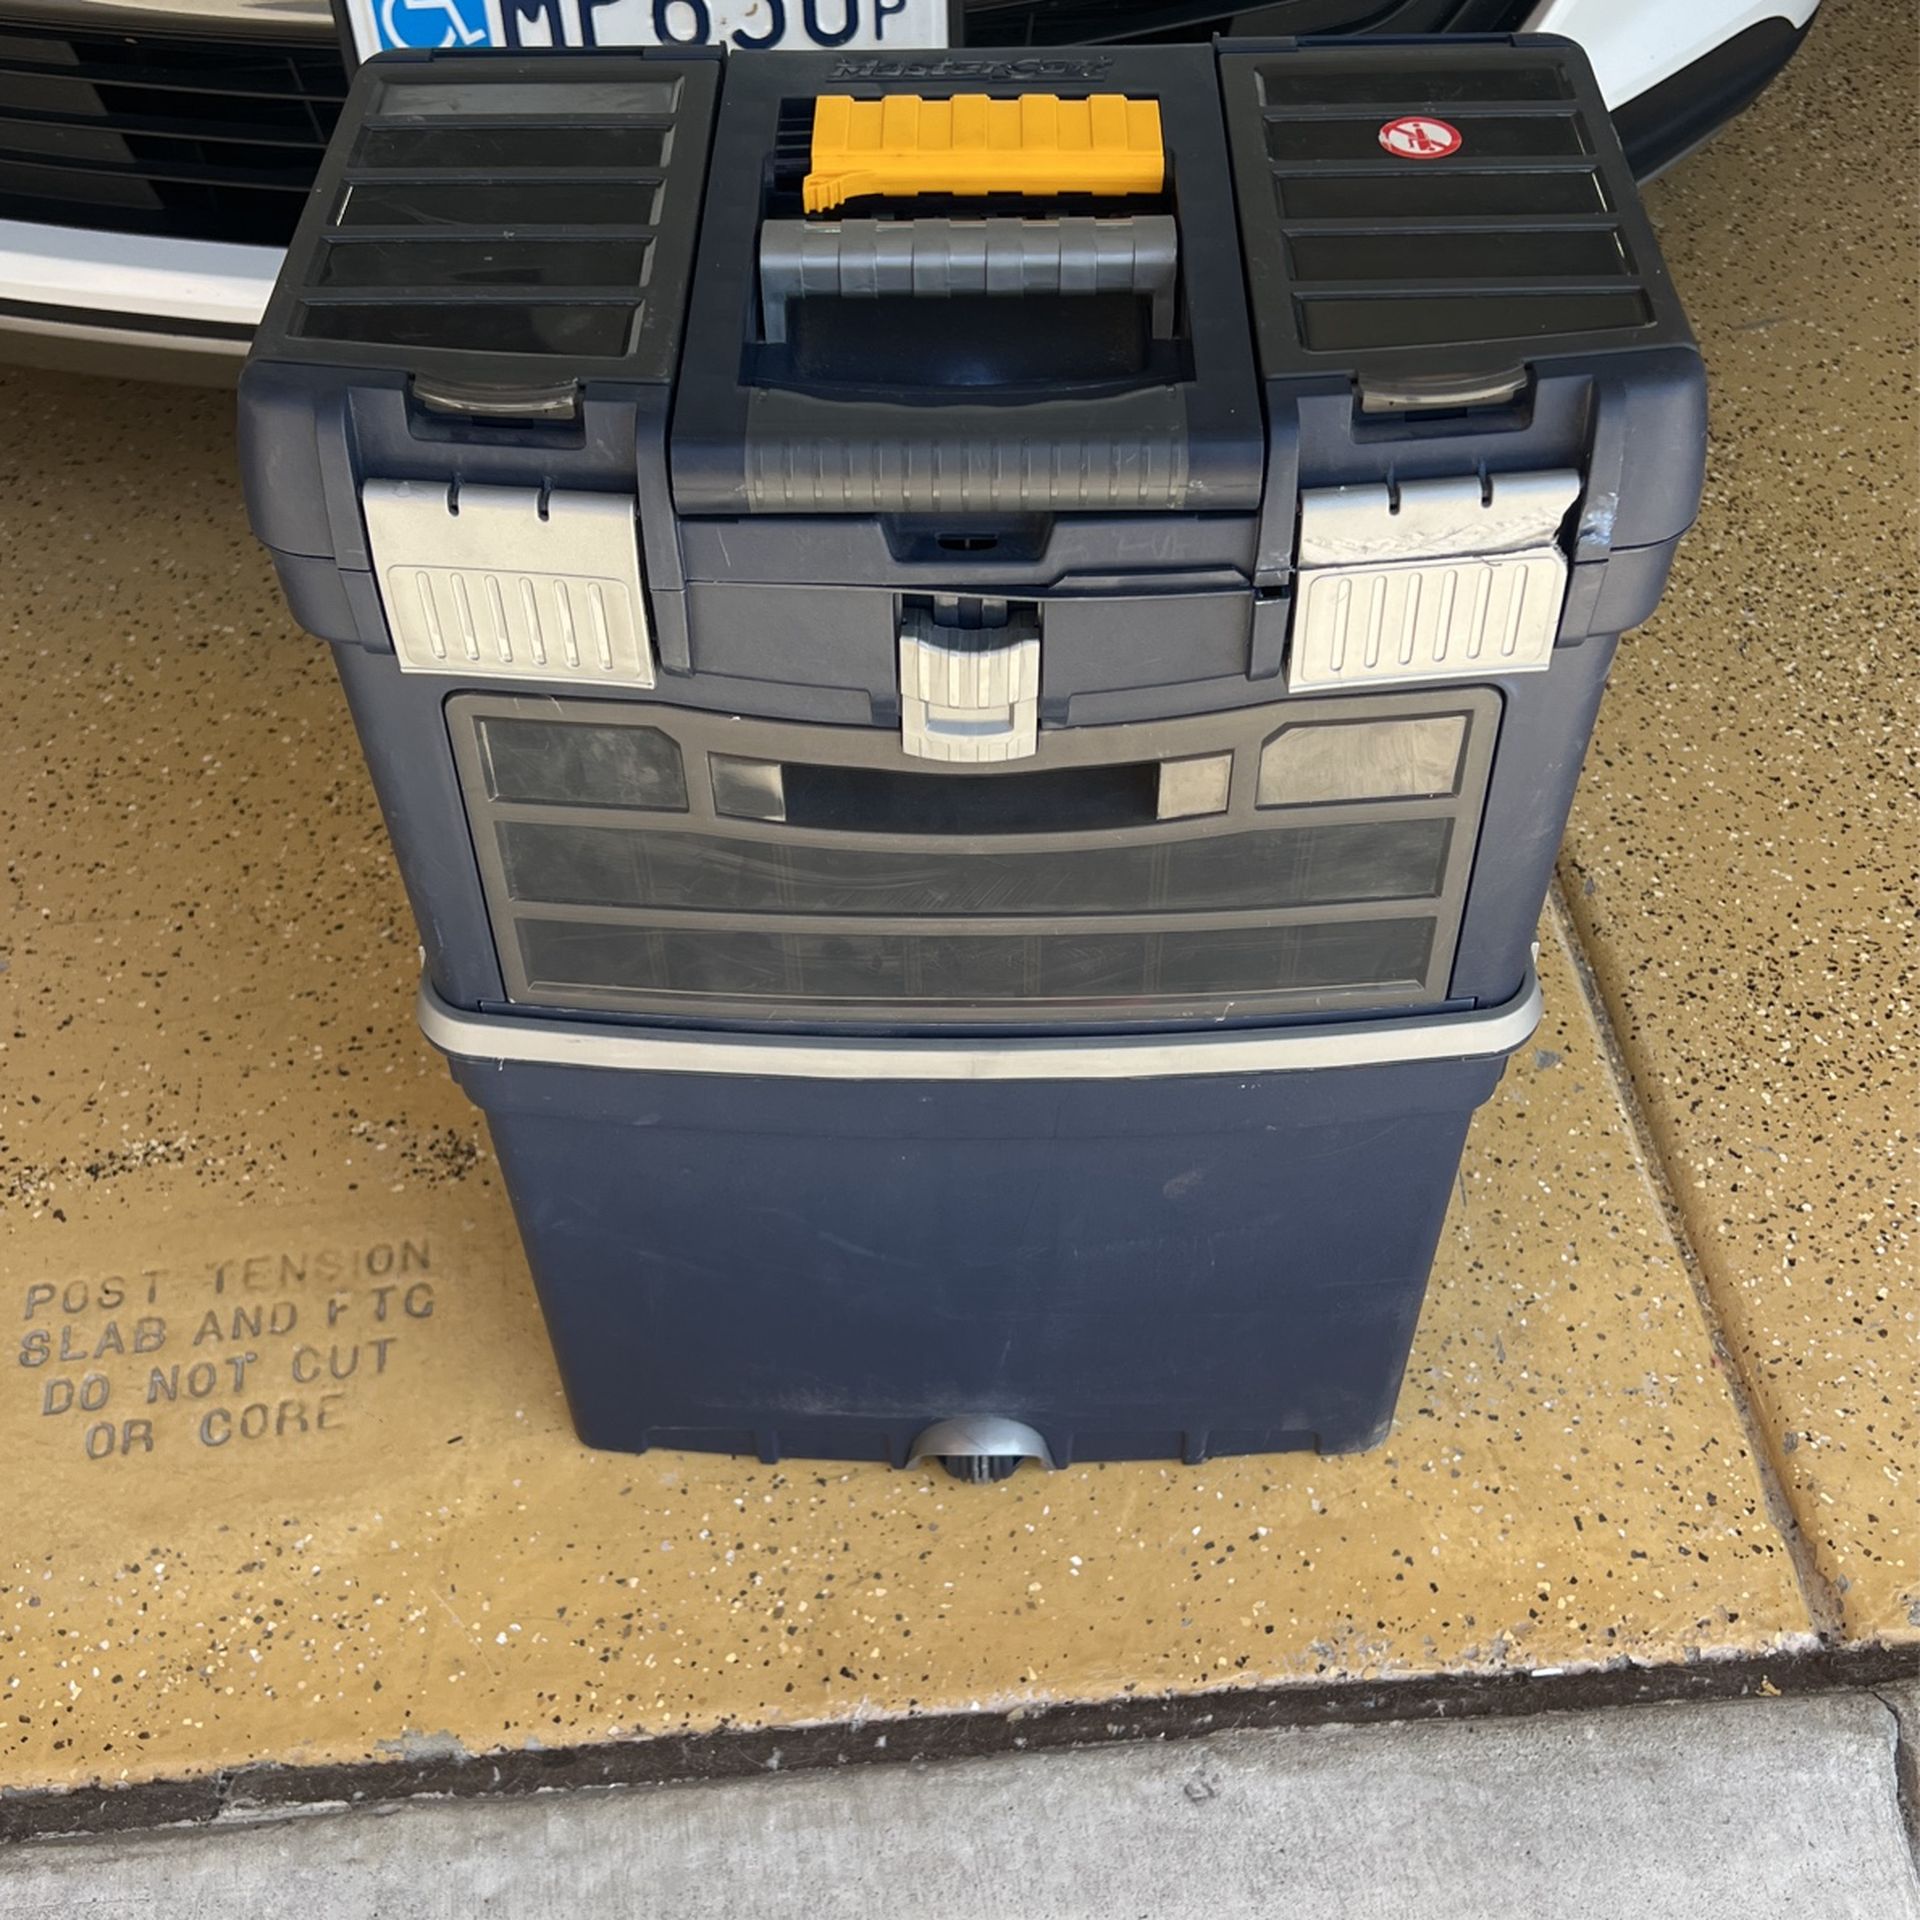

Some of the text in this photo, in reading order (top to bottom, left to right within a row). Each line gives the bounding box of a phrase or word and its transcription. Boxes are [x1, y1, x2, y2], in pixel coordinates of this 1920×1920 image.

[23, 1239, 431, 1321] POST TENSION
[18, 1316, 167, 1368] SLAB
[193, 1301, 298, 1346] AND
[42, 1337, 398, 1416] DO NOT CUT
[85, 1392, 346, 1460] OR CORE
